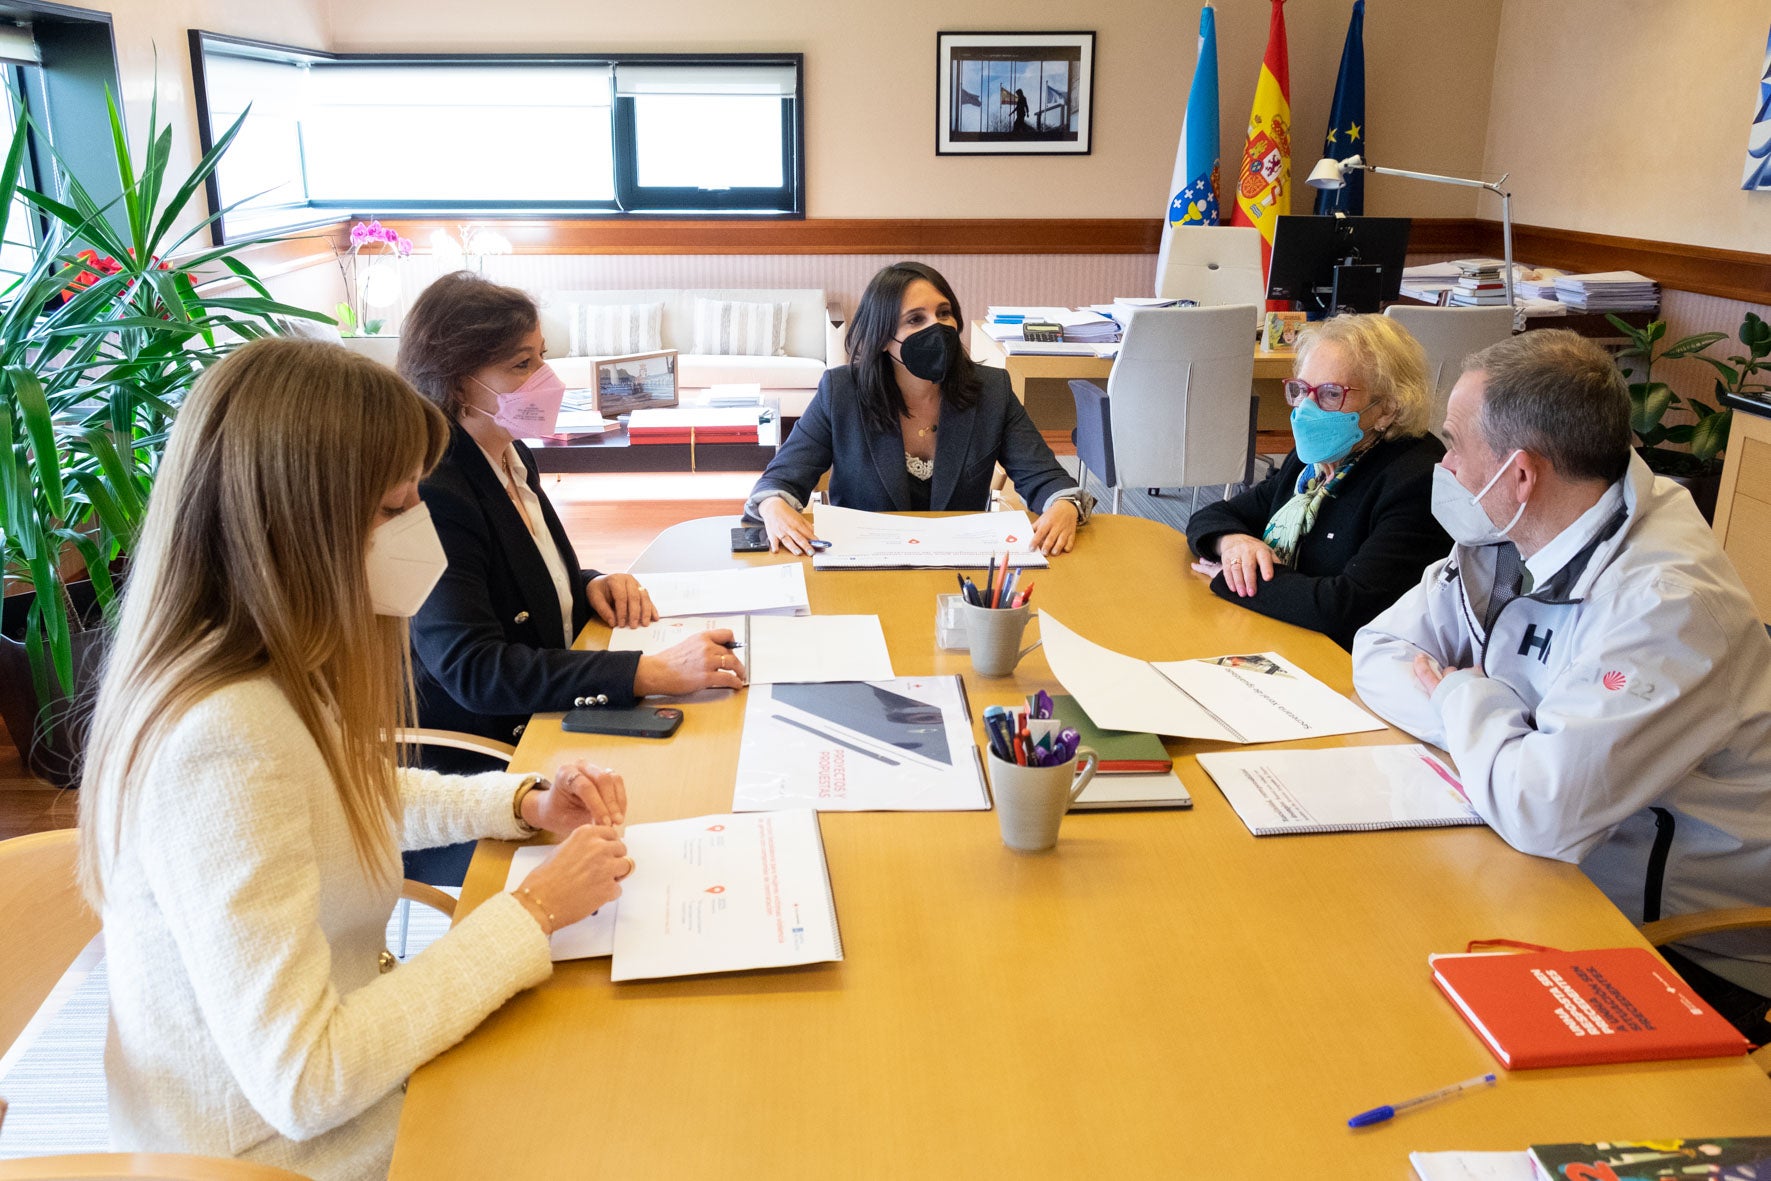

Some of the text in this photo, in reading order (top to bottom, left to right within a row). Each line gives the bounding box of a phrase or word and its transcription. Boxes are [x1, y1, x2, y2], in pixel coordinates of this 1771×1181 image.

[818, 751, 831, 799] PROPUESTAS
[833, 749, 846, 792] PROYECTOS
[1571, 965, 1592, 983] SEN
[1530, 969, 1601, 1036] RESPOSTA SEN
[1545, 969, 1615, 1035] PRECEDENTES
[1554, 1007, 1586, 1037] UNHA
[1590, 997, 1620, 1024] UNHA
